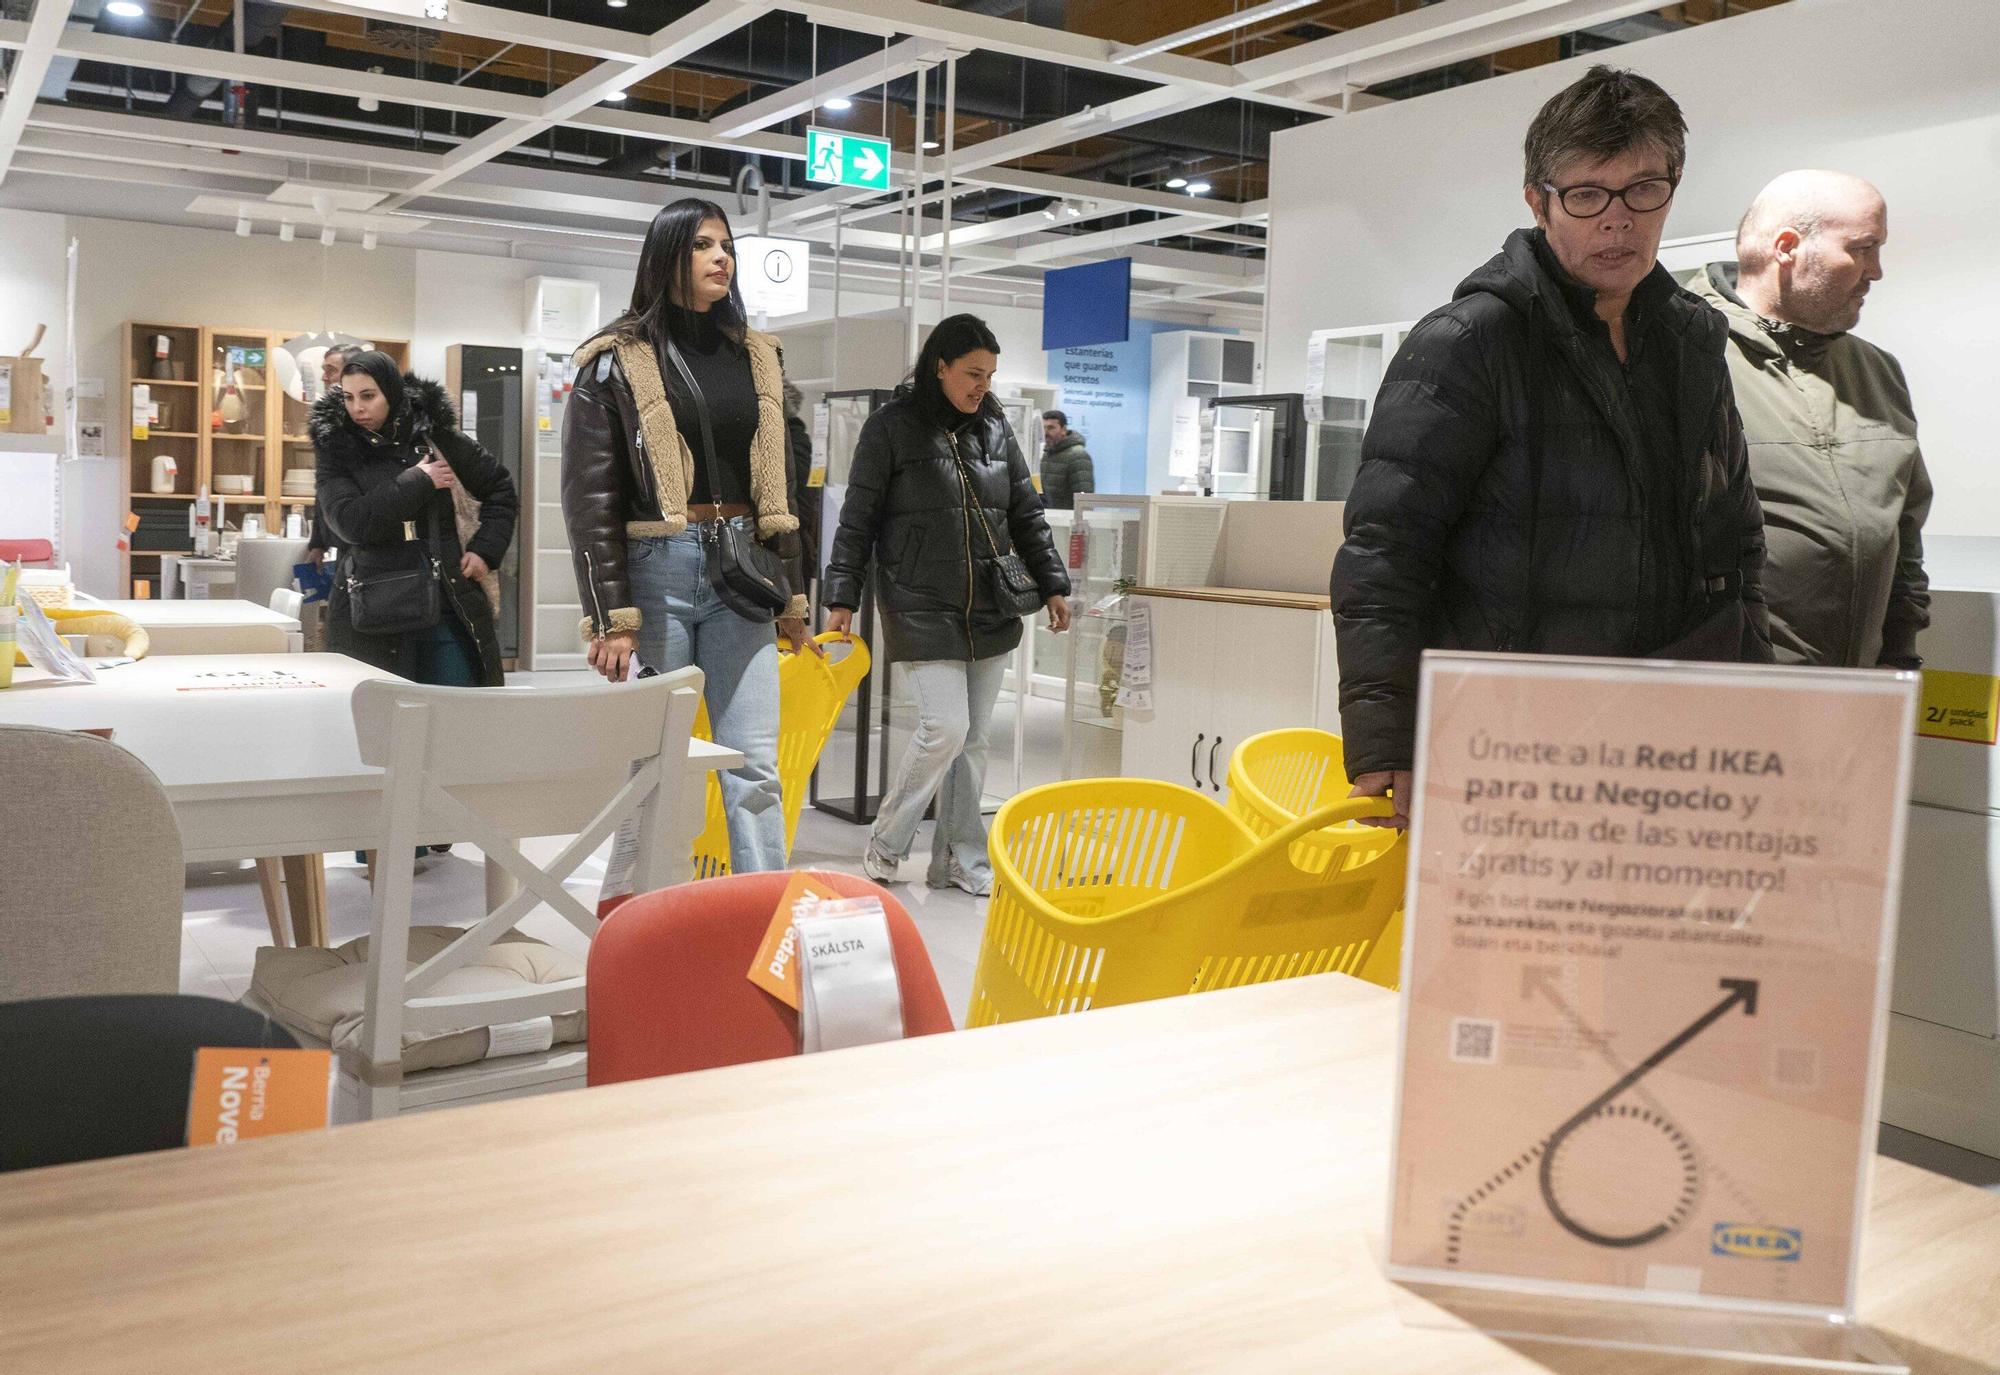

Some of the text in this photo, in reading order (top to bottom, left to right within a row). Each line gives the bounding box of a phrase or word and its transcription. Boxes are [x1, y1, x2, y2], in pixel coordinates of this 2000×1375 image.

[1064, 361, 1118, 373] que guardan
[1064, 374, 1100, 385] secretos
[1468, 728, 1784, 777] Únete a la Red IKEA
[1465, 777, 1539, 805] para
[1550, 780, 1584, 804] tu
[1595, 780, 1732, 815] Negocio
[1741, 794, 1761, 821] y
[1460, 811, 1818, 862] disfruta de las ventajas
[1560, 859, 1581, 886] y
[1585, 854, 1614, 881] al
[1622, 861, 1787, 892] momento!
[811, 938, 865, 958] SKÅLSTA
[1722, 1232, 1791, 1250] IKEA
